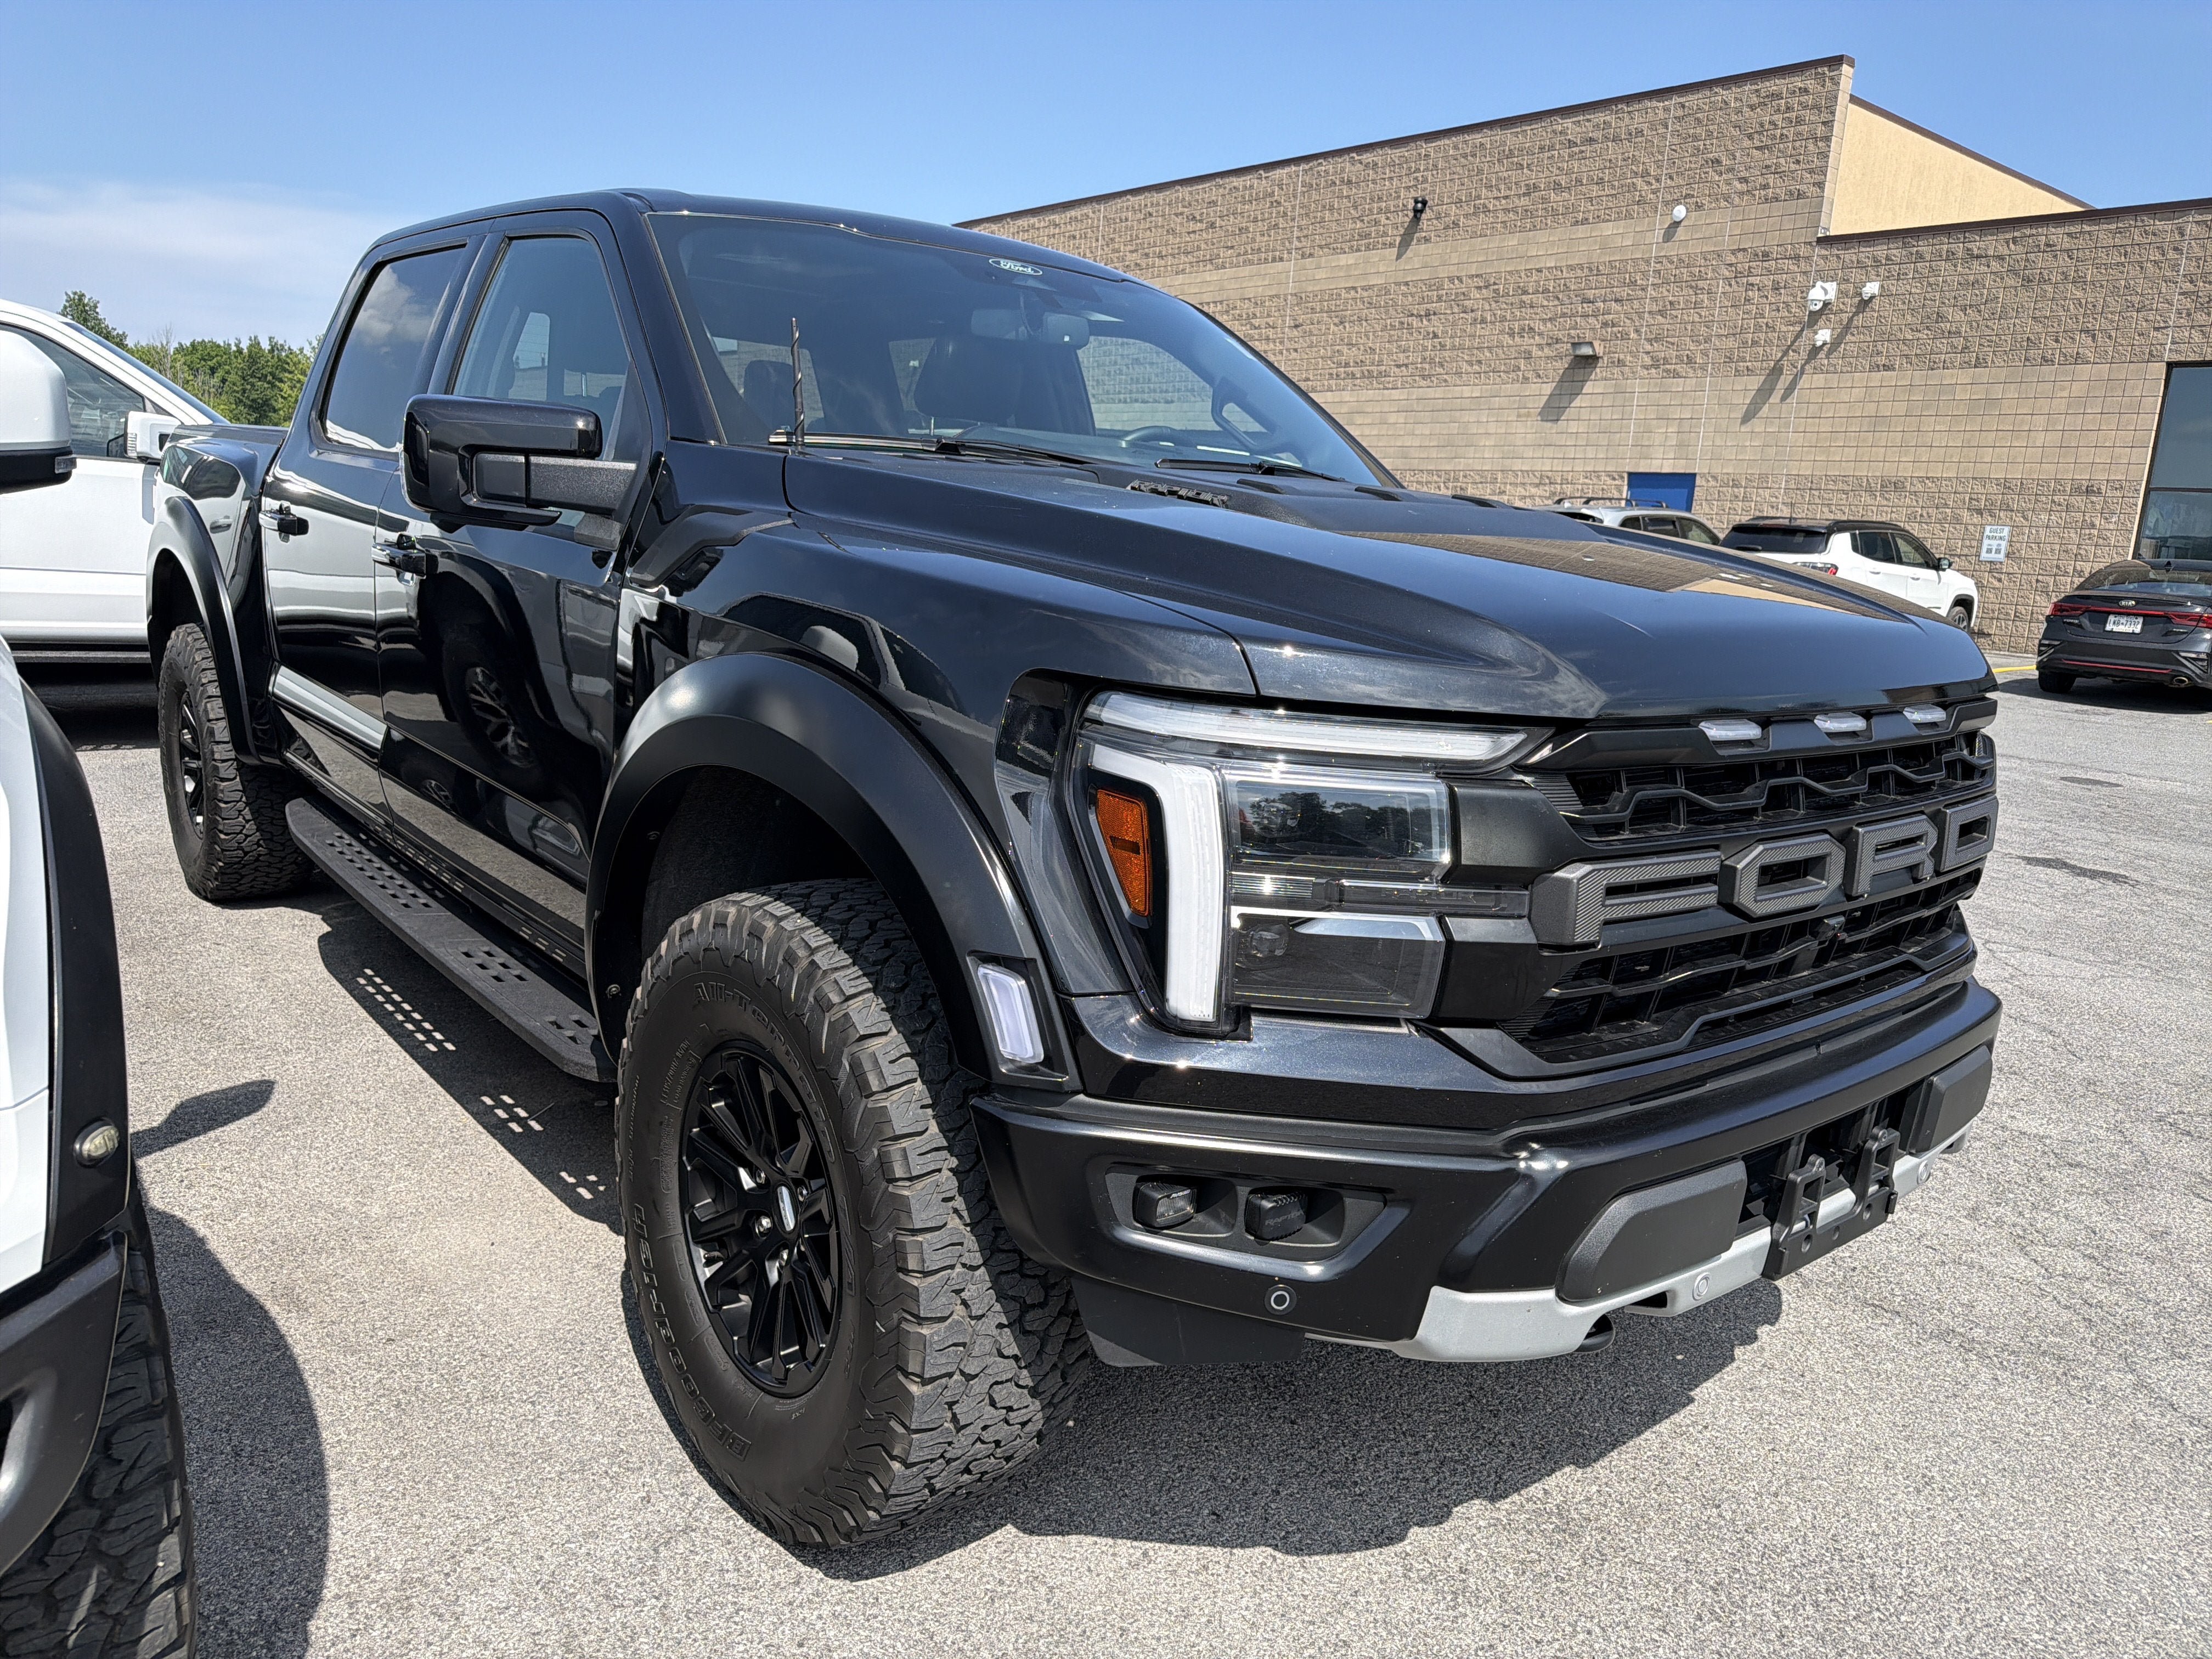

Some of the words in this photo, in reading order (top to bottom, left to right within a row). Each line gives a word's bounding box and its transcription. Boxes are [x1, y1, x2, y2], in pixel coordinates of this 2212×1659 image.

[1000, 260, 1034, 273] Ford
[1130, 479, 1230, 509] RAPTOR
[1533, 793, 1999, 946] FORD
[633, 1203, 753, 1462] BFGOODRICH
